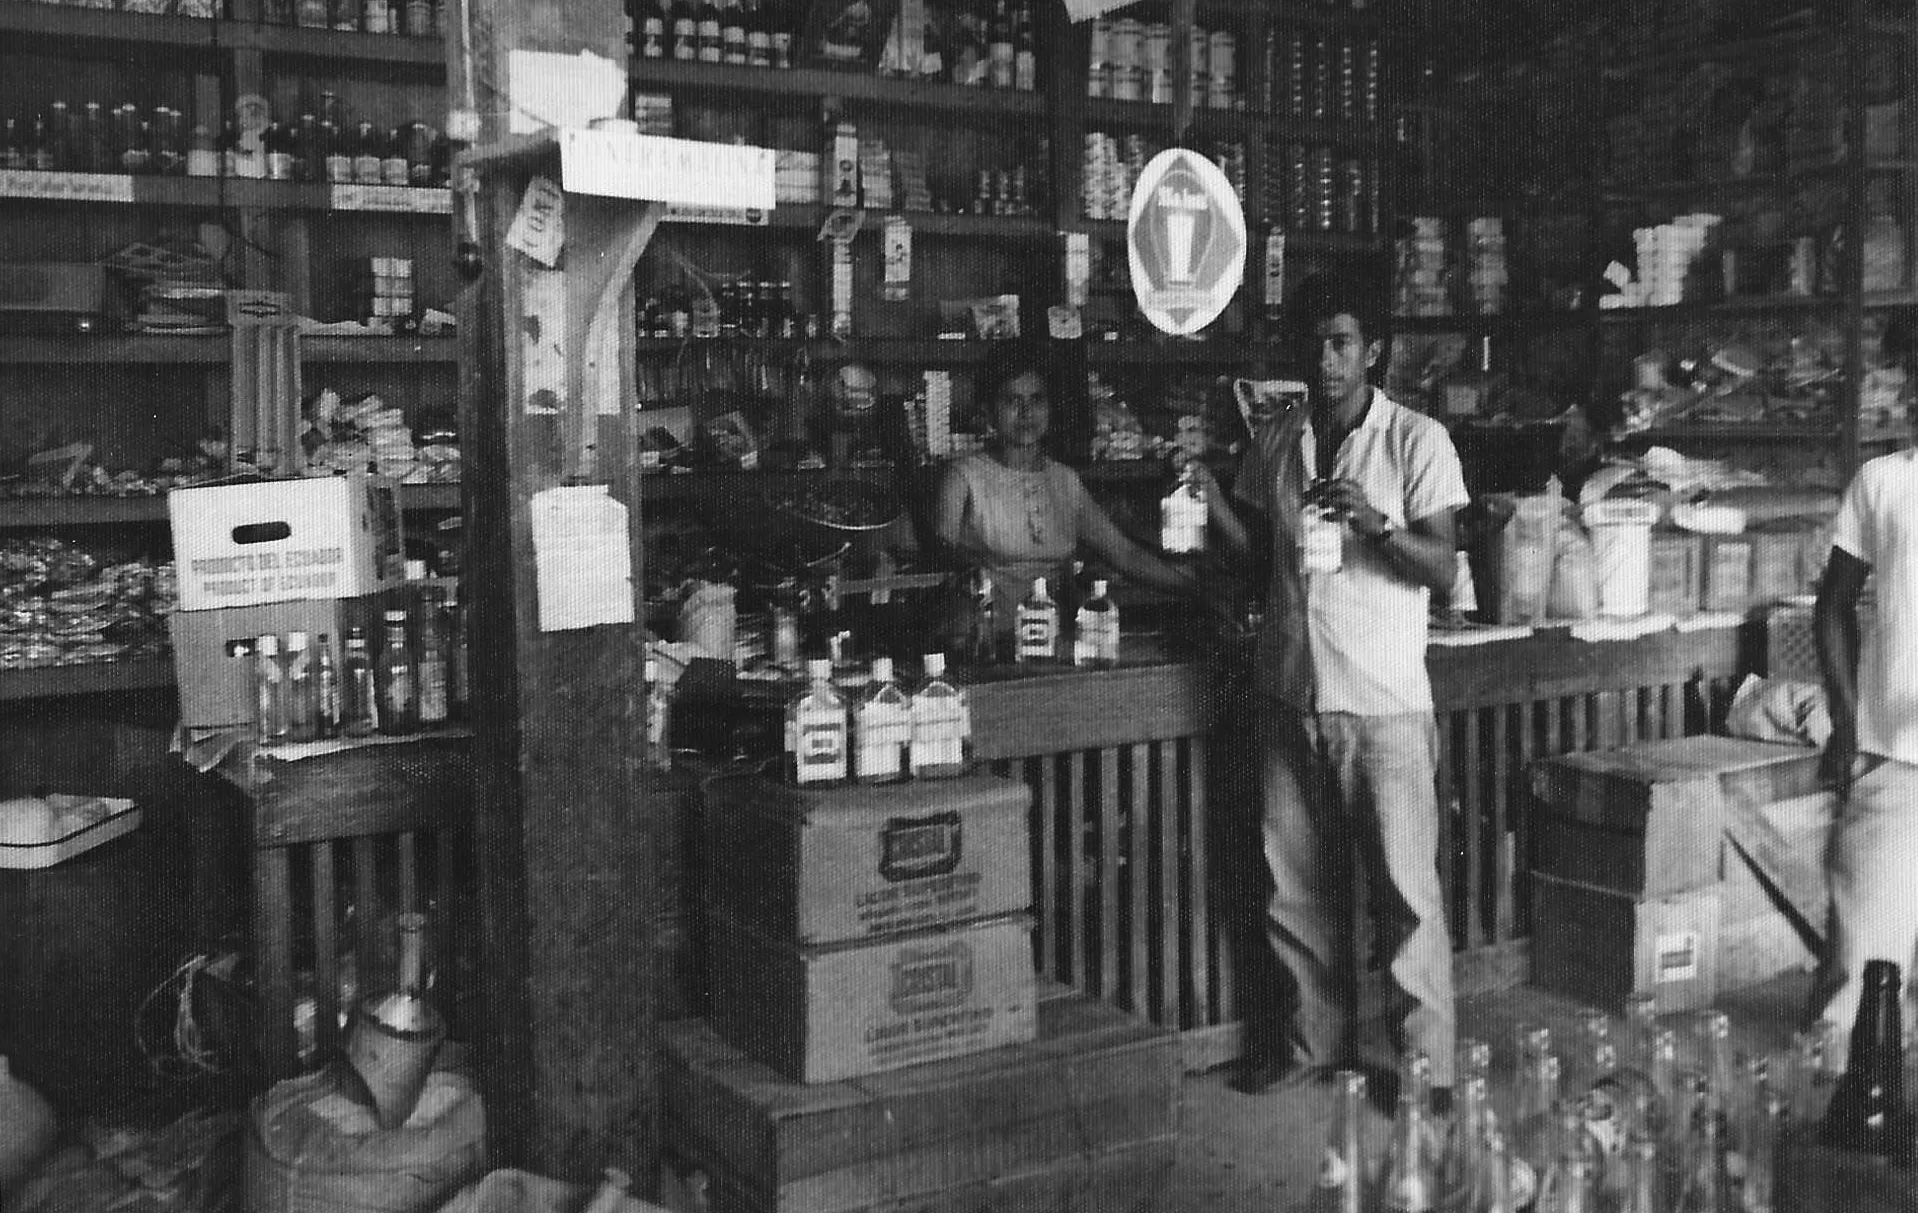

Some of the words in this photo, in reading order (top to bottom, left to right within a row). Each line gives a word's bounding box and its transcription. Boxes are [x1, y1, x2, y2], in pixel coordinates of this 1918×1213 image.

[191, 554, 256, 575] PRODUCTO
[259, 552, 280, 571] DEL
[286, 547, 344, 569] ECUADOR
[203, 578, 256, 596] PRODUCT
[261, 576, 275, 592] OF
[280, 571, 337, 591] ECUADOR
